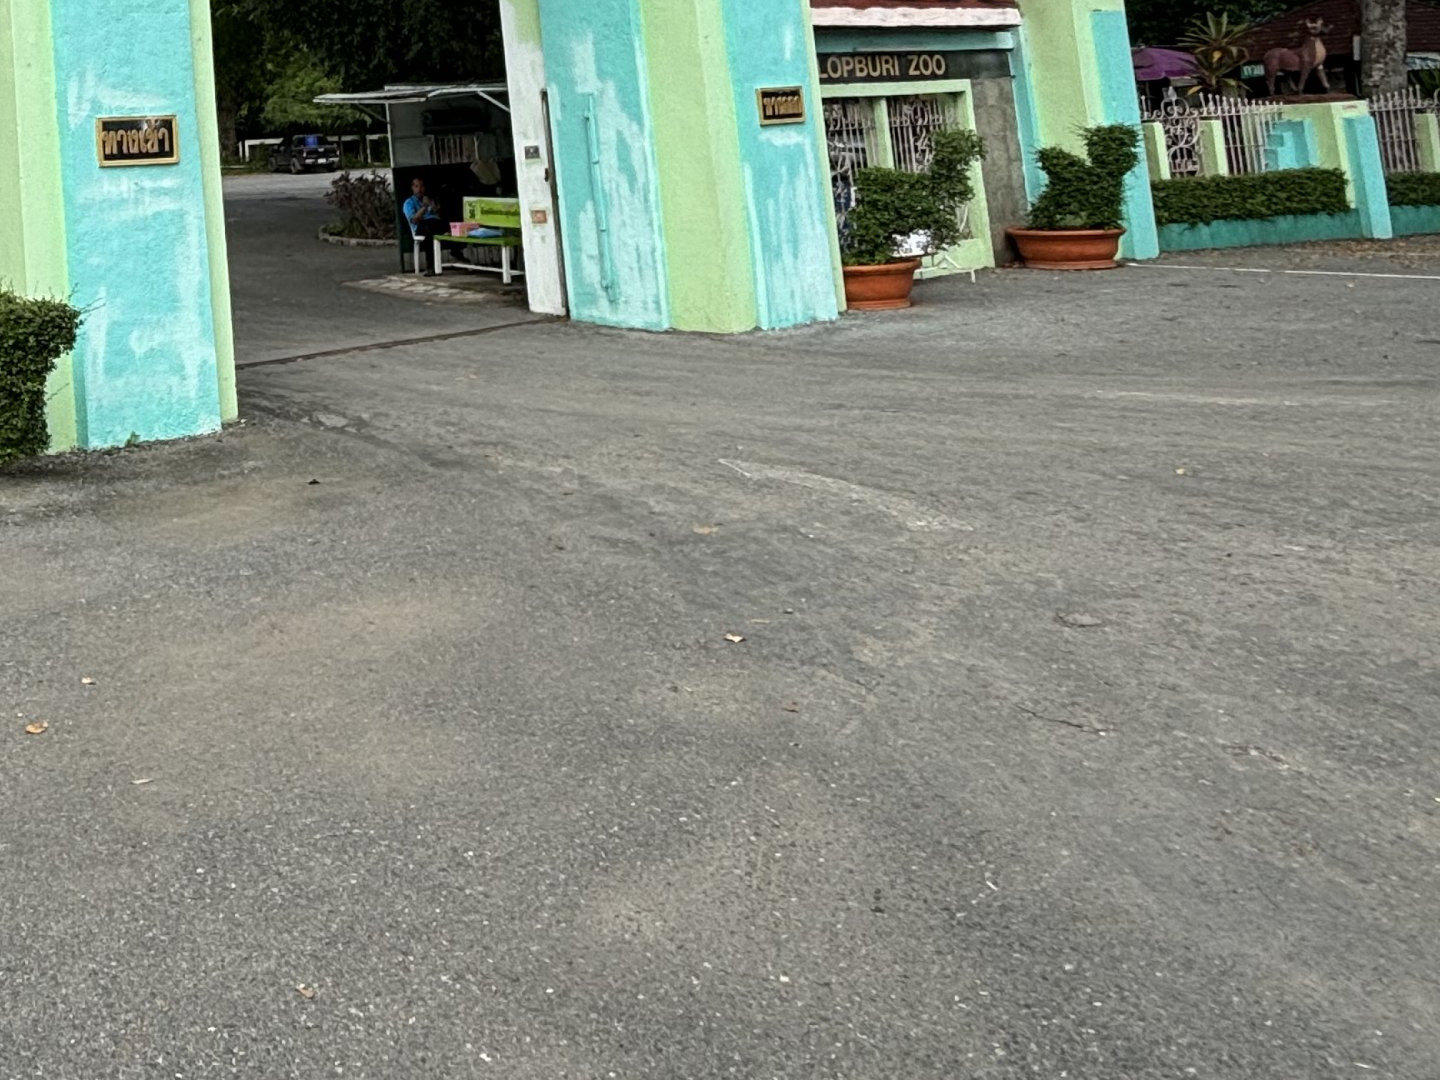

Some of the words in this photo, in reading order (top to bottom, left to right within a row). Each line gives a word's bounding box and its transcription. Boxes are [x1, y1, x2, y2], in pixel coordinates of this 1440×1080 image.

[907, 53, 946, 76] ZOO
[101, 117, 170, 155] ทางเข้า
